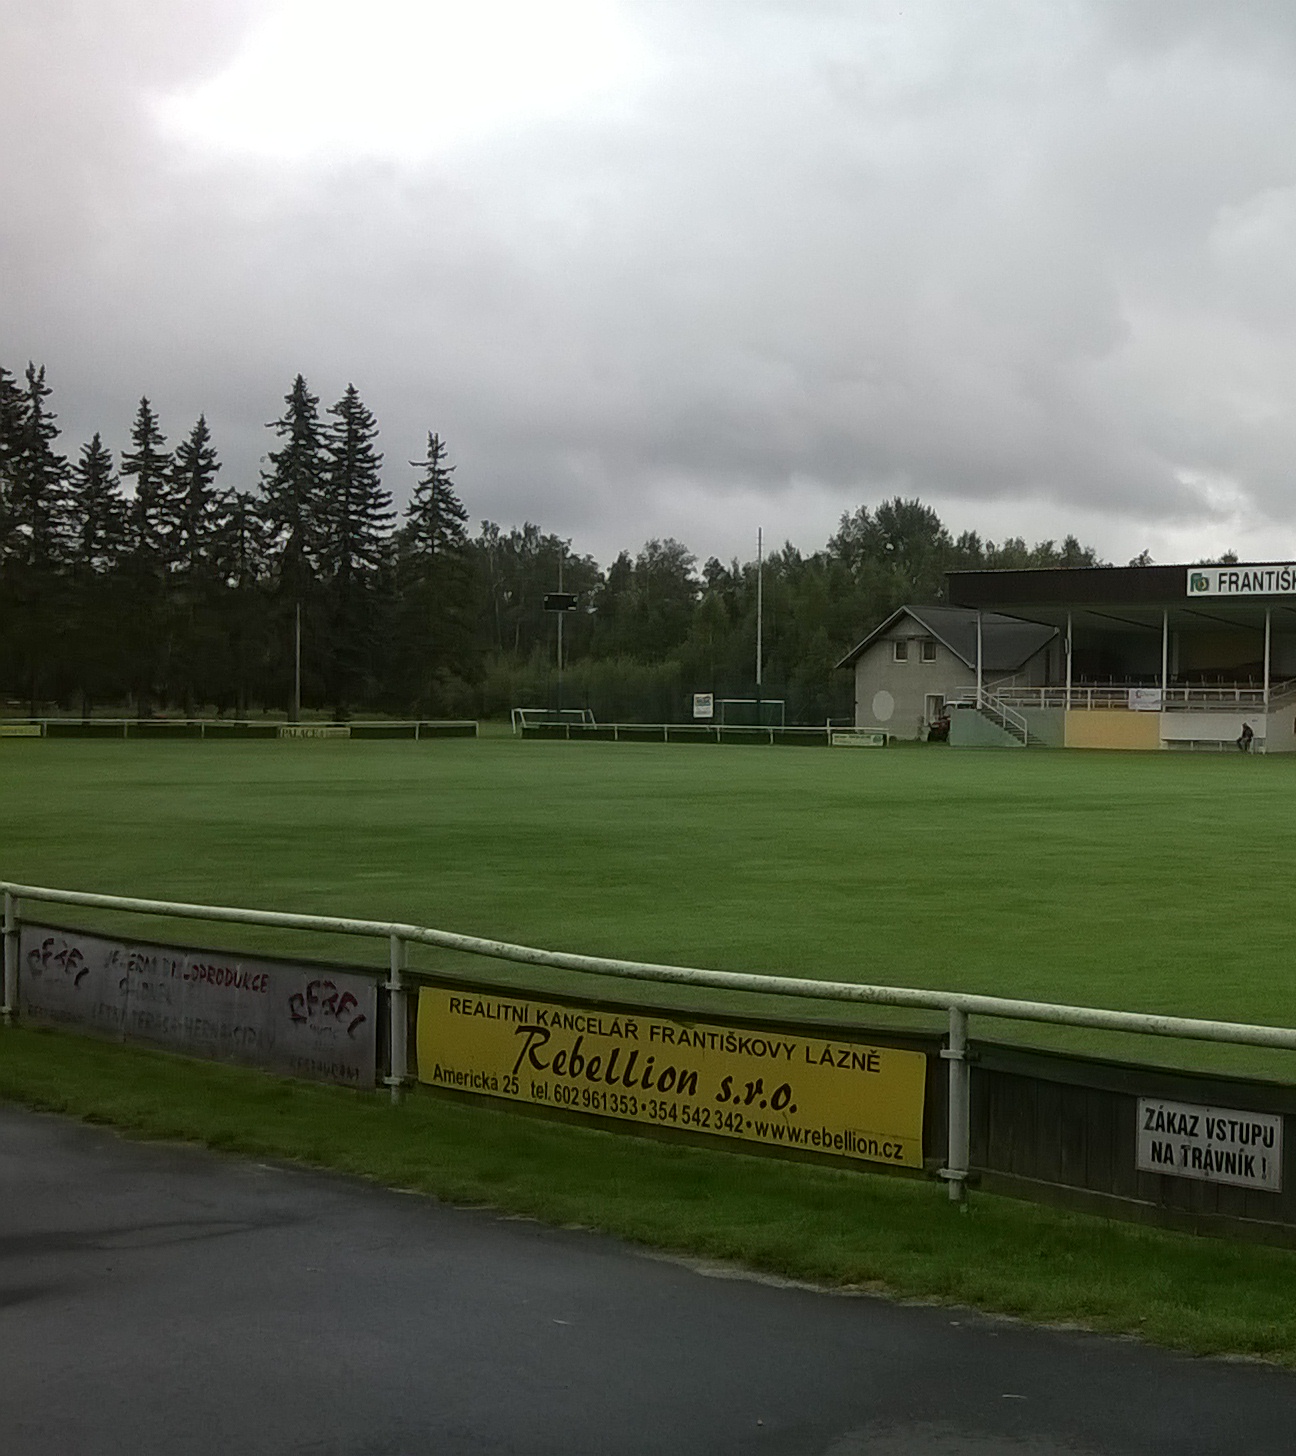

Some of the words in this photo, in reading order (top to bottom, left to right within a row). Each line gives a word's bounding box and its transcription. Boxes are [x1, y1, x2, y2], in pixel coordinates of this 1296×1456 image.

[449, 996, 531, 1024] REALITNÍ
[535, 1008, 640, 1041] KANCELÁŘ
[649, 1024, 798, 1062] FRANTIŠKOVY
[804, 1043, 882, 1074] LÁZNĚ
[512, 1024, 700, 1098] Rebellion
[502, 1074, 520, 1096] 25
[530, 1079, 551, 1101] tel.
[1142, 1104, 1200, 1138] ZÁKAZ
[1205, 1116, 1275, 1149] VSTUPU
[1150, 1140, 1175, 1166] NA
[1180, 1143, 1257, 1179] TRÁVNÍK
